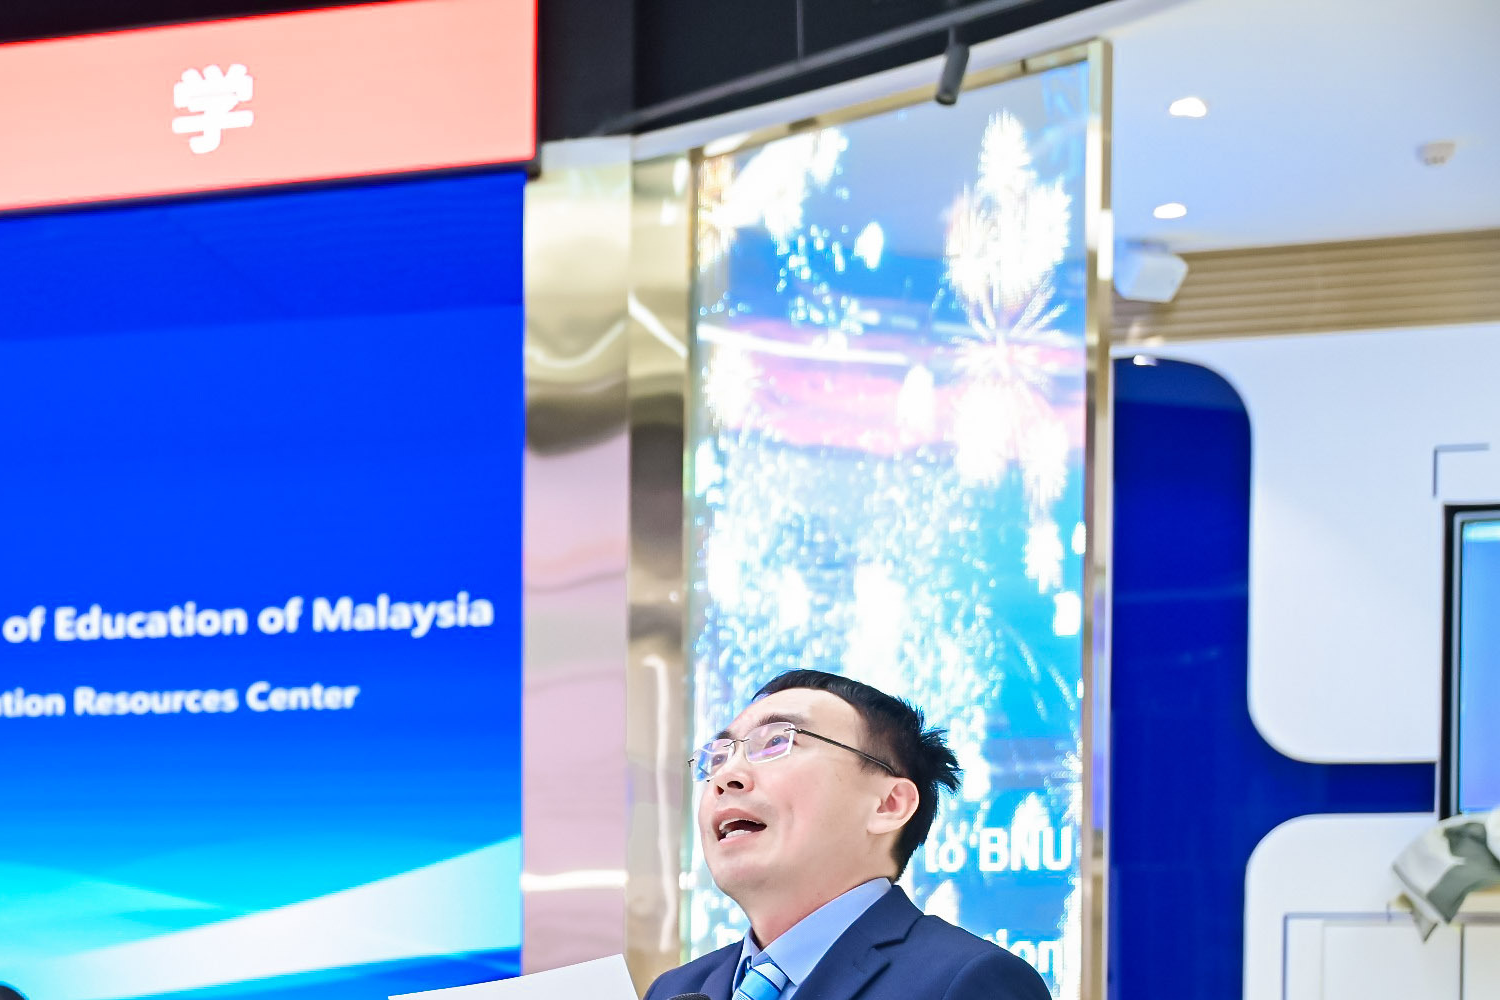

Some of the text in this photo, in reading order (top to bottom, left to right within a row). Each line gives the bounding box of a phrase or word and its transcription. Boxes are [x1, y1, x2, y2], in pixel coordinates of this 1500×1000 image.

[2, 604, 47, 643] of
[53, 601, 249, 642] Education
[257, 596, 304, 635] of
[312, 591, 495, 639] Malaysia
[74, 685, 240, 716] Resources
[245, 681, 360, 713] Center
[924, 826, 1073, 873] to BNU
